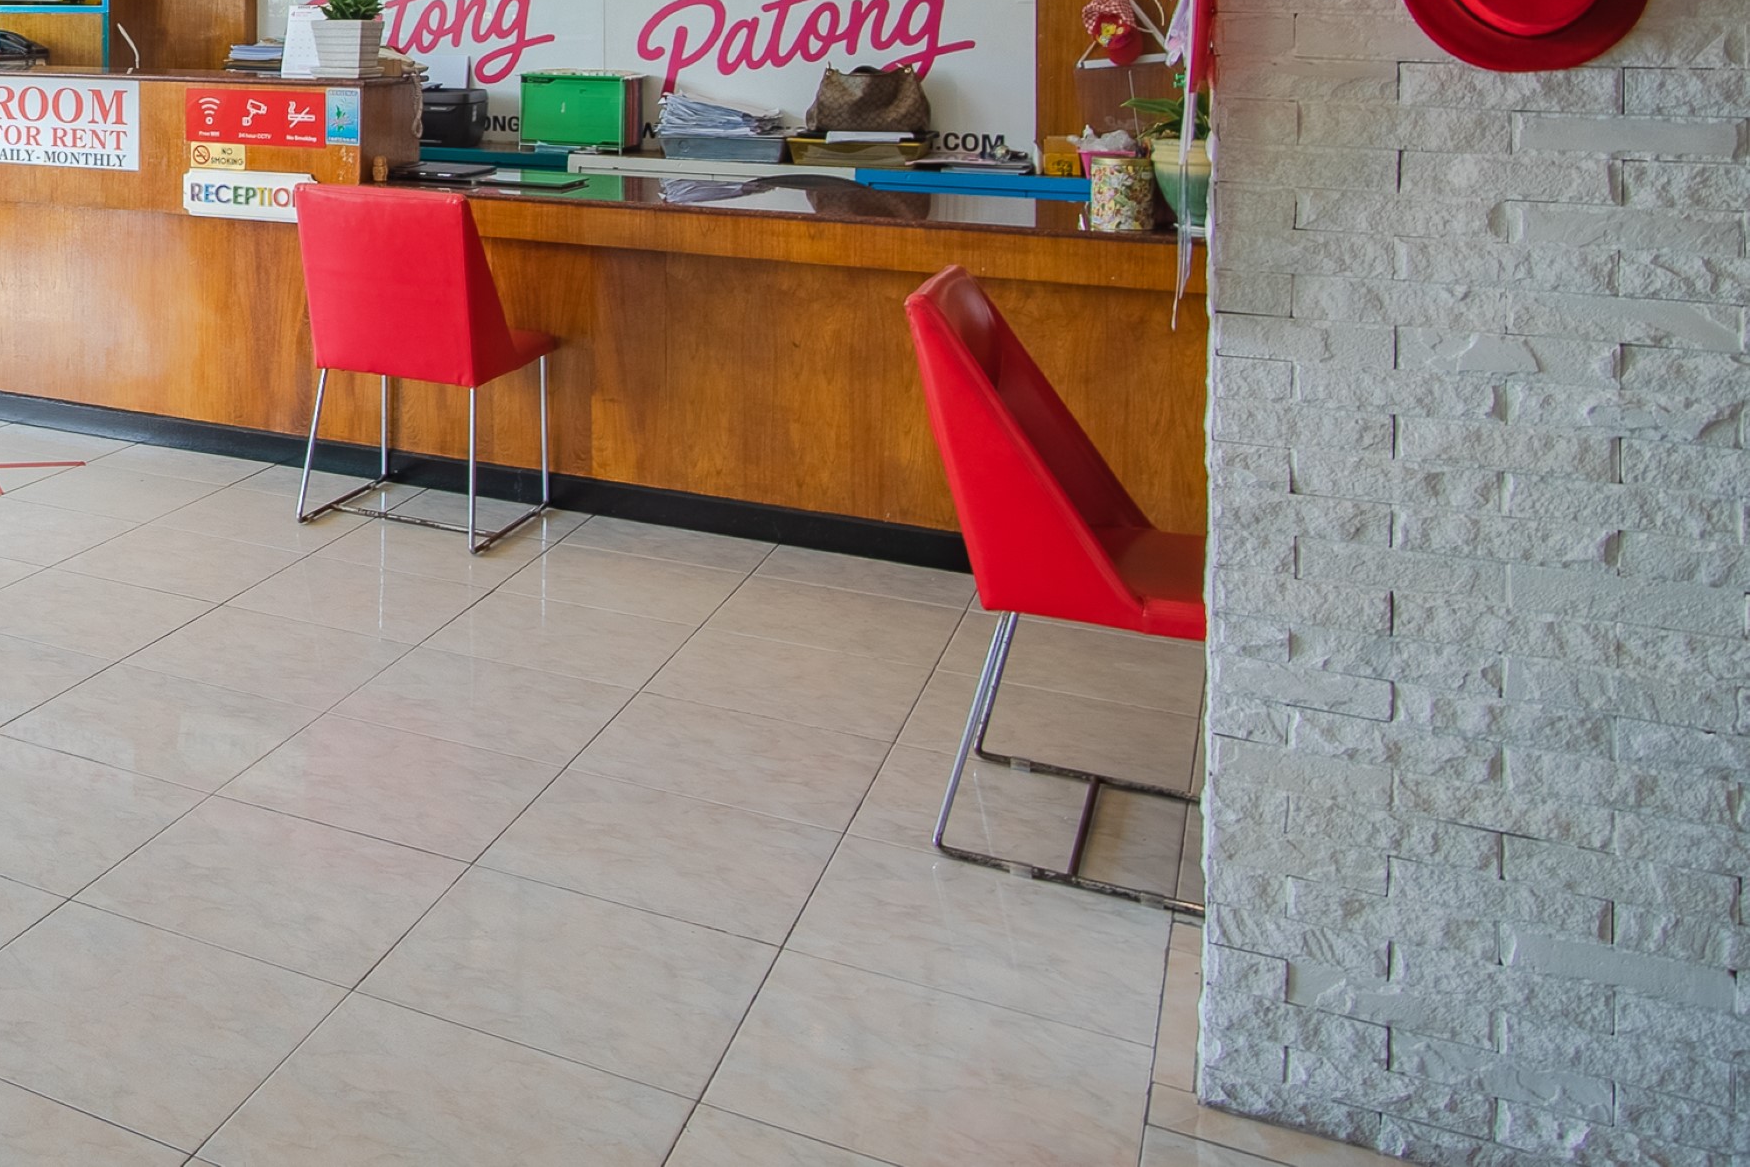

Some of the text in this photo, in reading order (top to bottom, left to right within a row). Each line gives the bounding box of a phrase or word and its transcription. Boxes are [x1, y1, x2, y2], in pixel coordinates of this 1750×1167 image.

[483, 115, 519, 133] ONG
[51, 127, 128, 150] RENT
[294, 135, 317, 143] Smoking
[221, 147, 233, 155] NO
[210, 156, 244, 166] SMOKING
[190, 182, 296, 208] RECEPTIO
